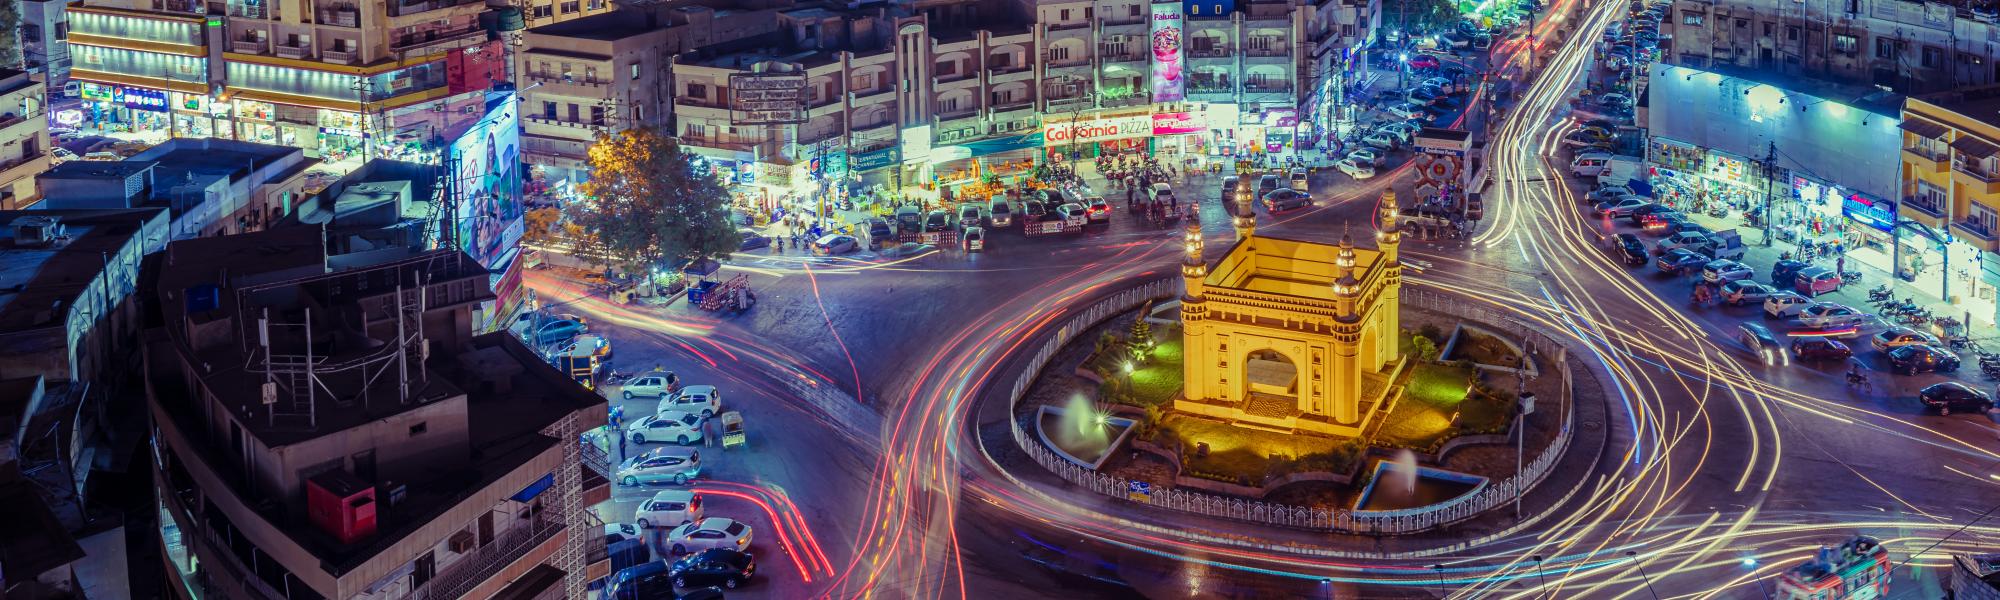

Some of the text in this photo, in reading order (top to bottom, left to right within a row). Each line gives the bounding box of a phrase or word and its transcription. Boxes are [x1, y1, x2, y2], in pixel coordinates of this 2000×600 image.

[732, 75, 805, 89] Mothercare
[1046, 122, 1118, 142] California
[1120, 120, 1150, 134] PIZZA
